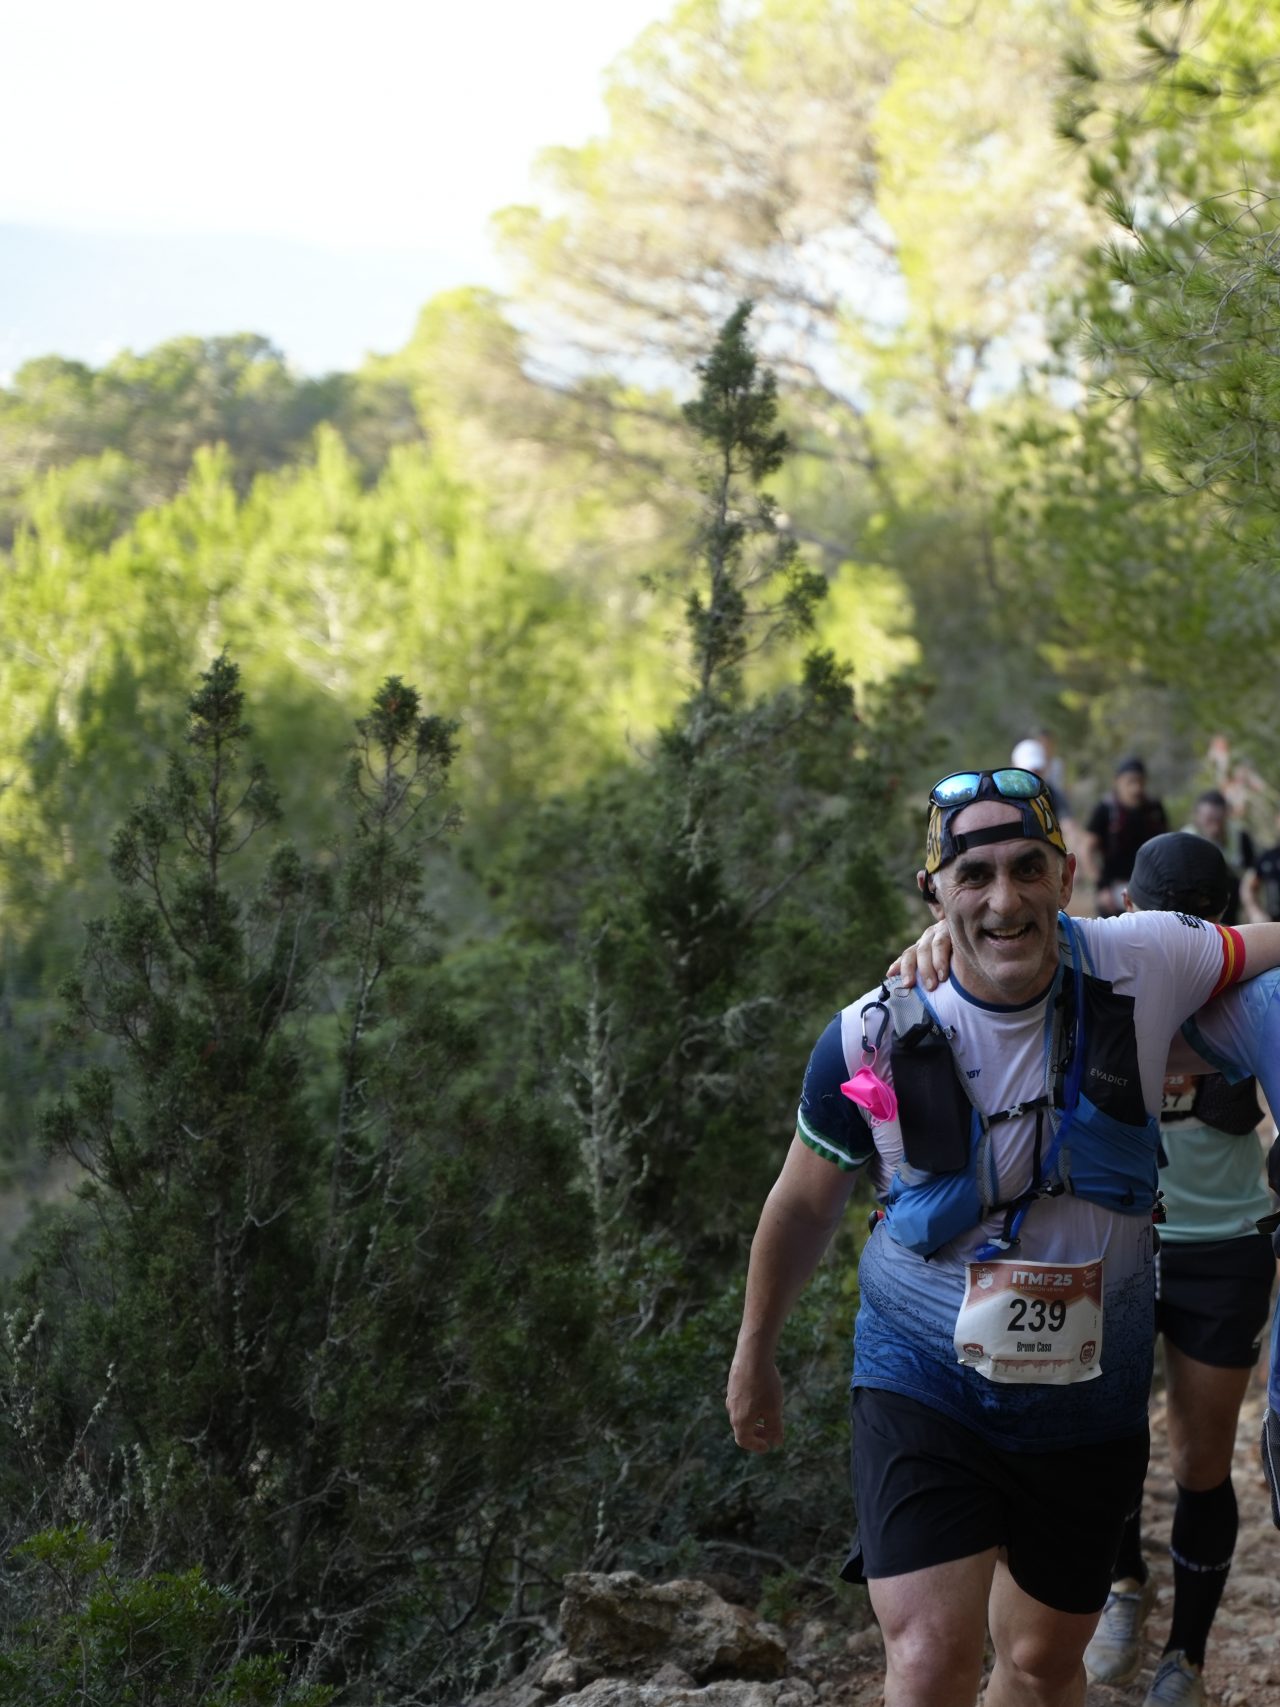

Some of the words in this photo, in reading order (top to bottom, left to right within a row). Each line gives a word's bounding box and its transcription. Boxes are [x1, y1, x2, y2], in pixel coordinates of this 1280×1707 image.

[1089, 1067, 1129, 1087] EVADICT
[1011, 1270, 1073, 1287] ITMF25
[1007, 1298, 1067, 1333] 239
[1016, 1341, 1036, 1353] Bruno
